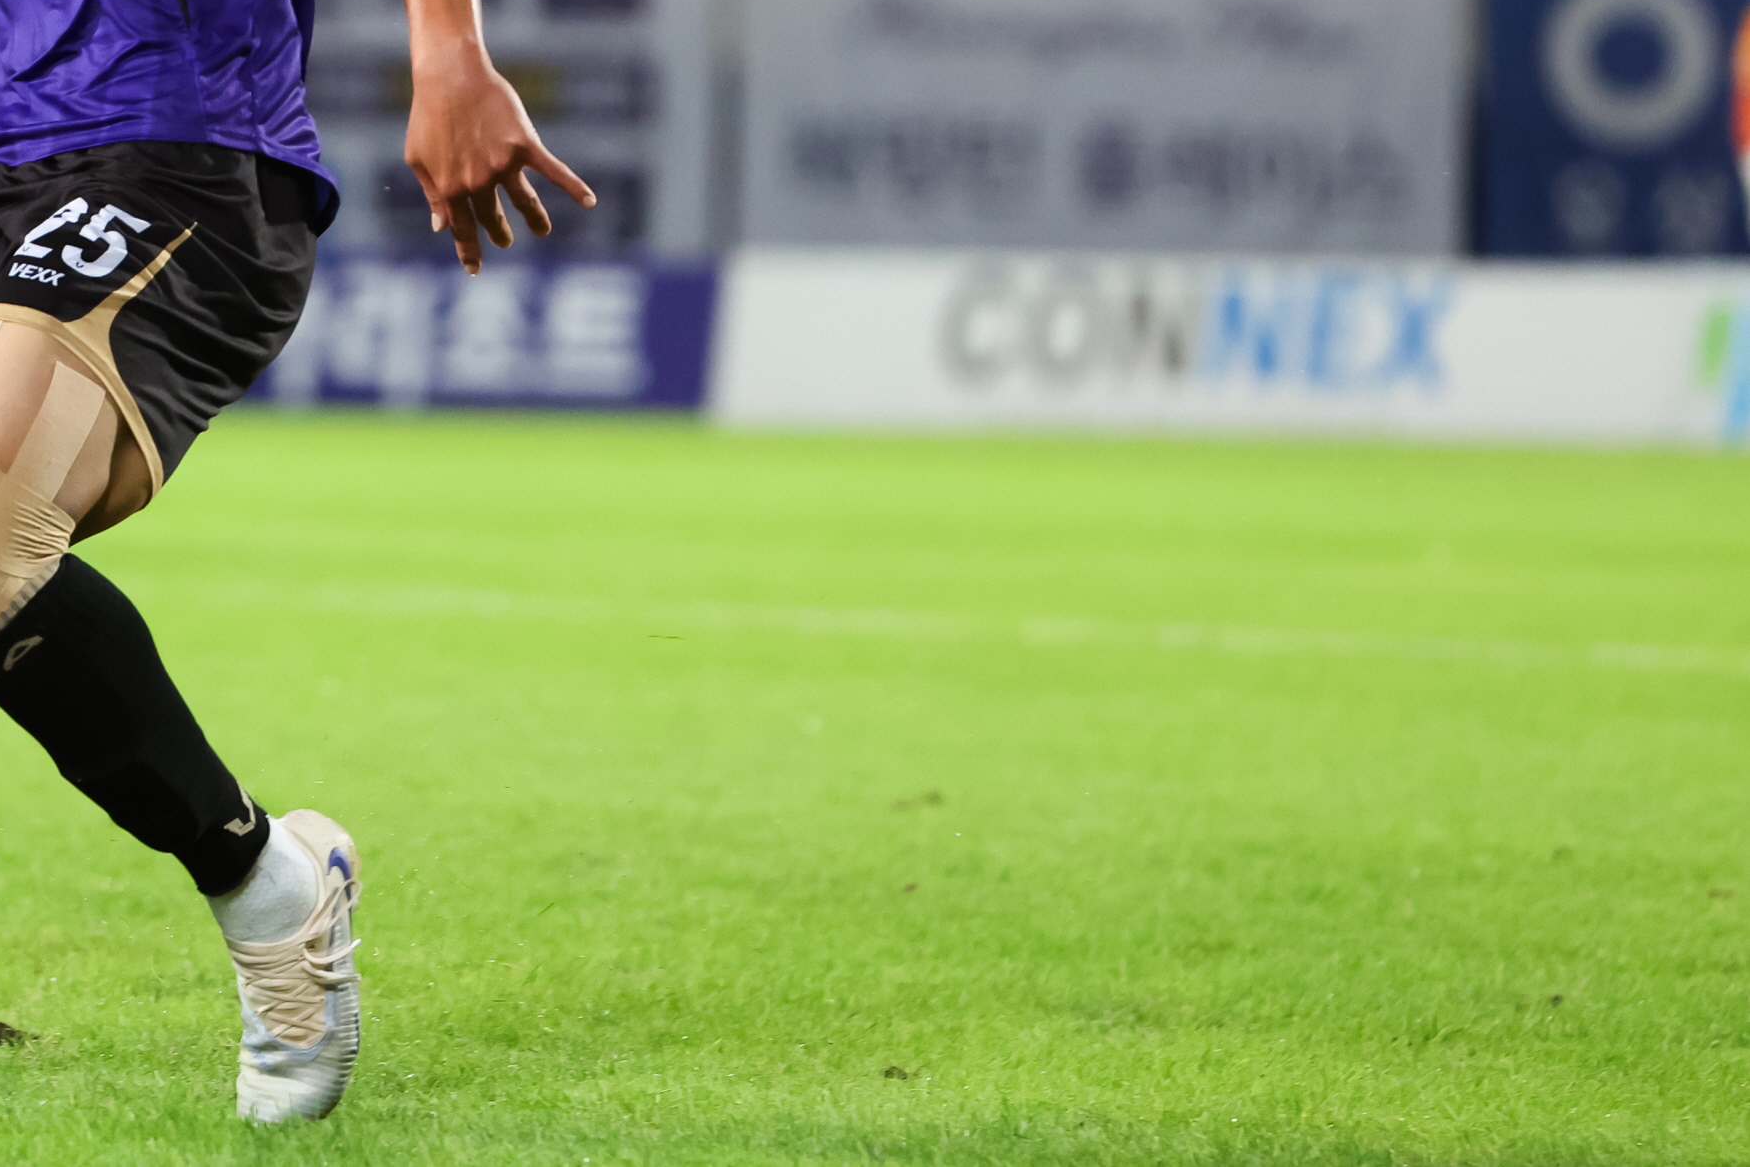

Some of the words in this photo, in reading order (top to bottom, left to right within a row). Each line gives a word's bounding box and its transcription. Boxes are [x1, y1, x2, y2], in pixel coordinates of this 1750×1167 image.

[8, 262, 65, 287] VEXX
[13, 196, 152, 278] 25
[940, 266, 1448, 388] CONNEX
